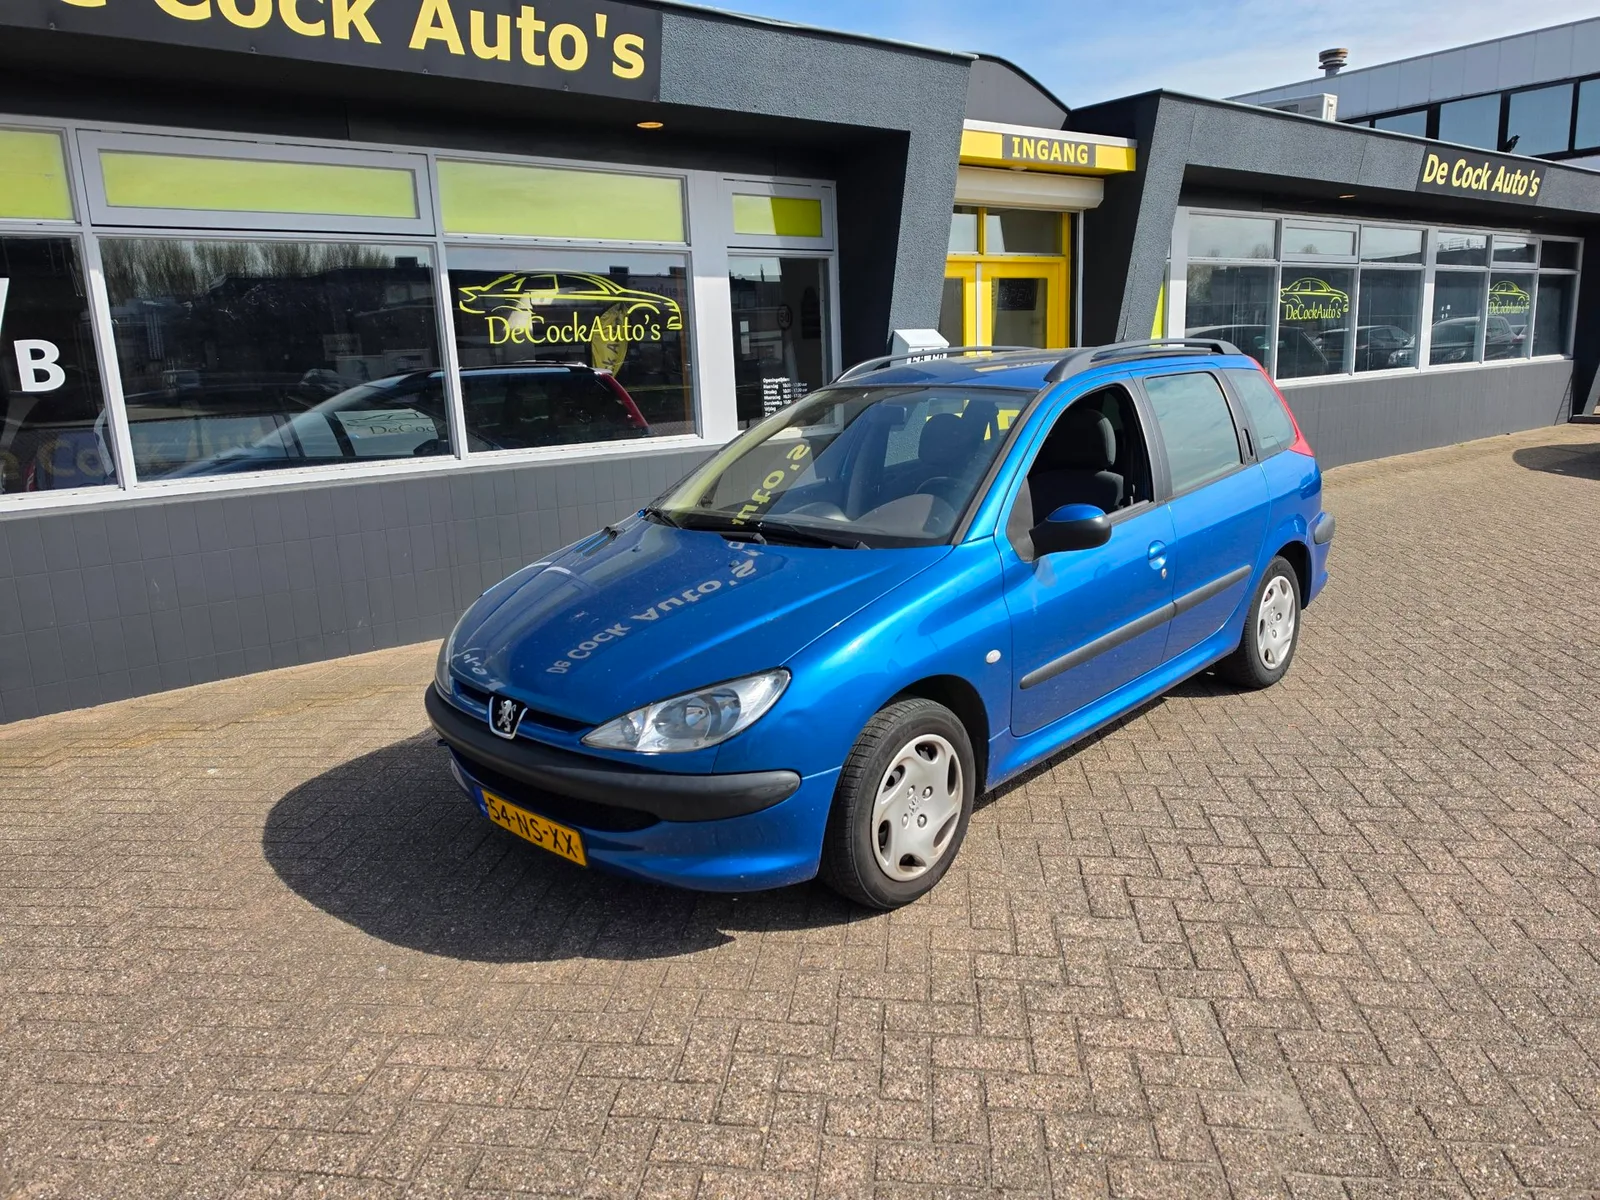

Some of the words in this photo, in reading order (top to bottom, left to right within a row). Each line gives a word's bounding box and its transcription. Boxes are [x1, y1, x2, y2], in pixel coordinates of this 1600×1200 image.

[408, 0, 645, 80] Auto's
[1012, 136, 1088, 165] INGANG
[1422, 153, 1449, 185] De
[1451, 158, 1492, 191] Cock
[1491, 165, 1541, 197] Auto's
[485, 311, 661, 345] DeCockAuto's
[1285, 301, 1342, 320] DeCockAuto's
[13, 339, 66, 392] B
[488, 797, 578, 858] 54-NS-XX
